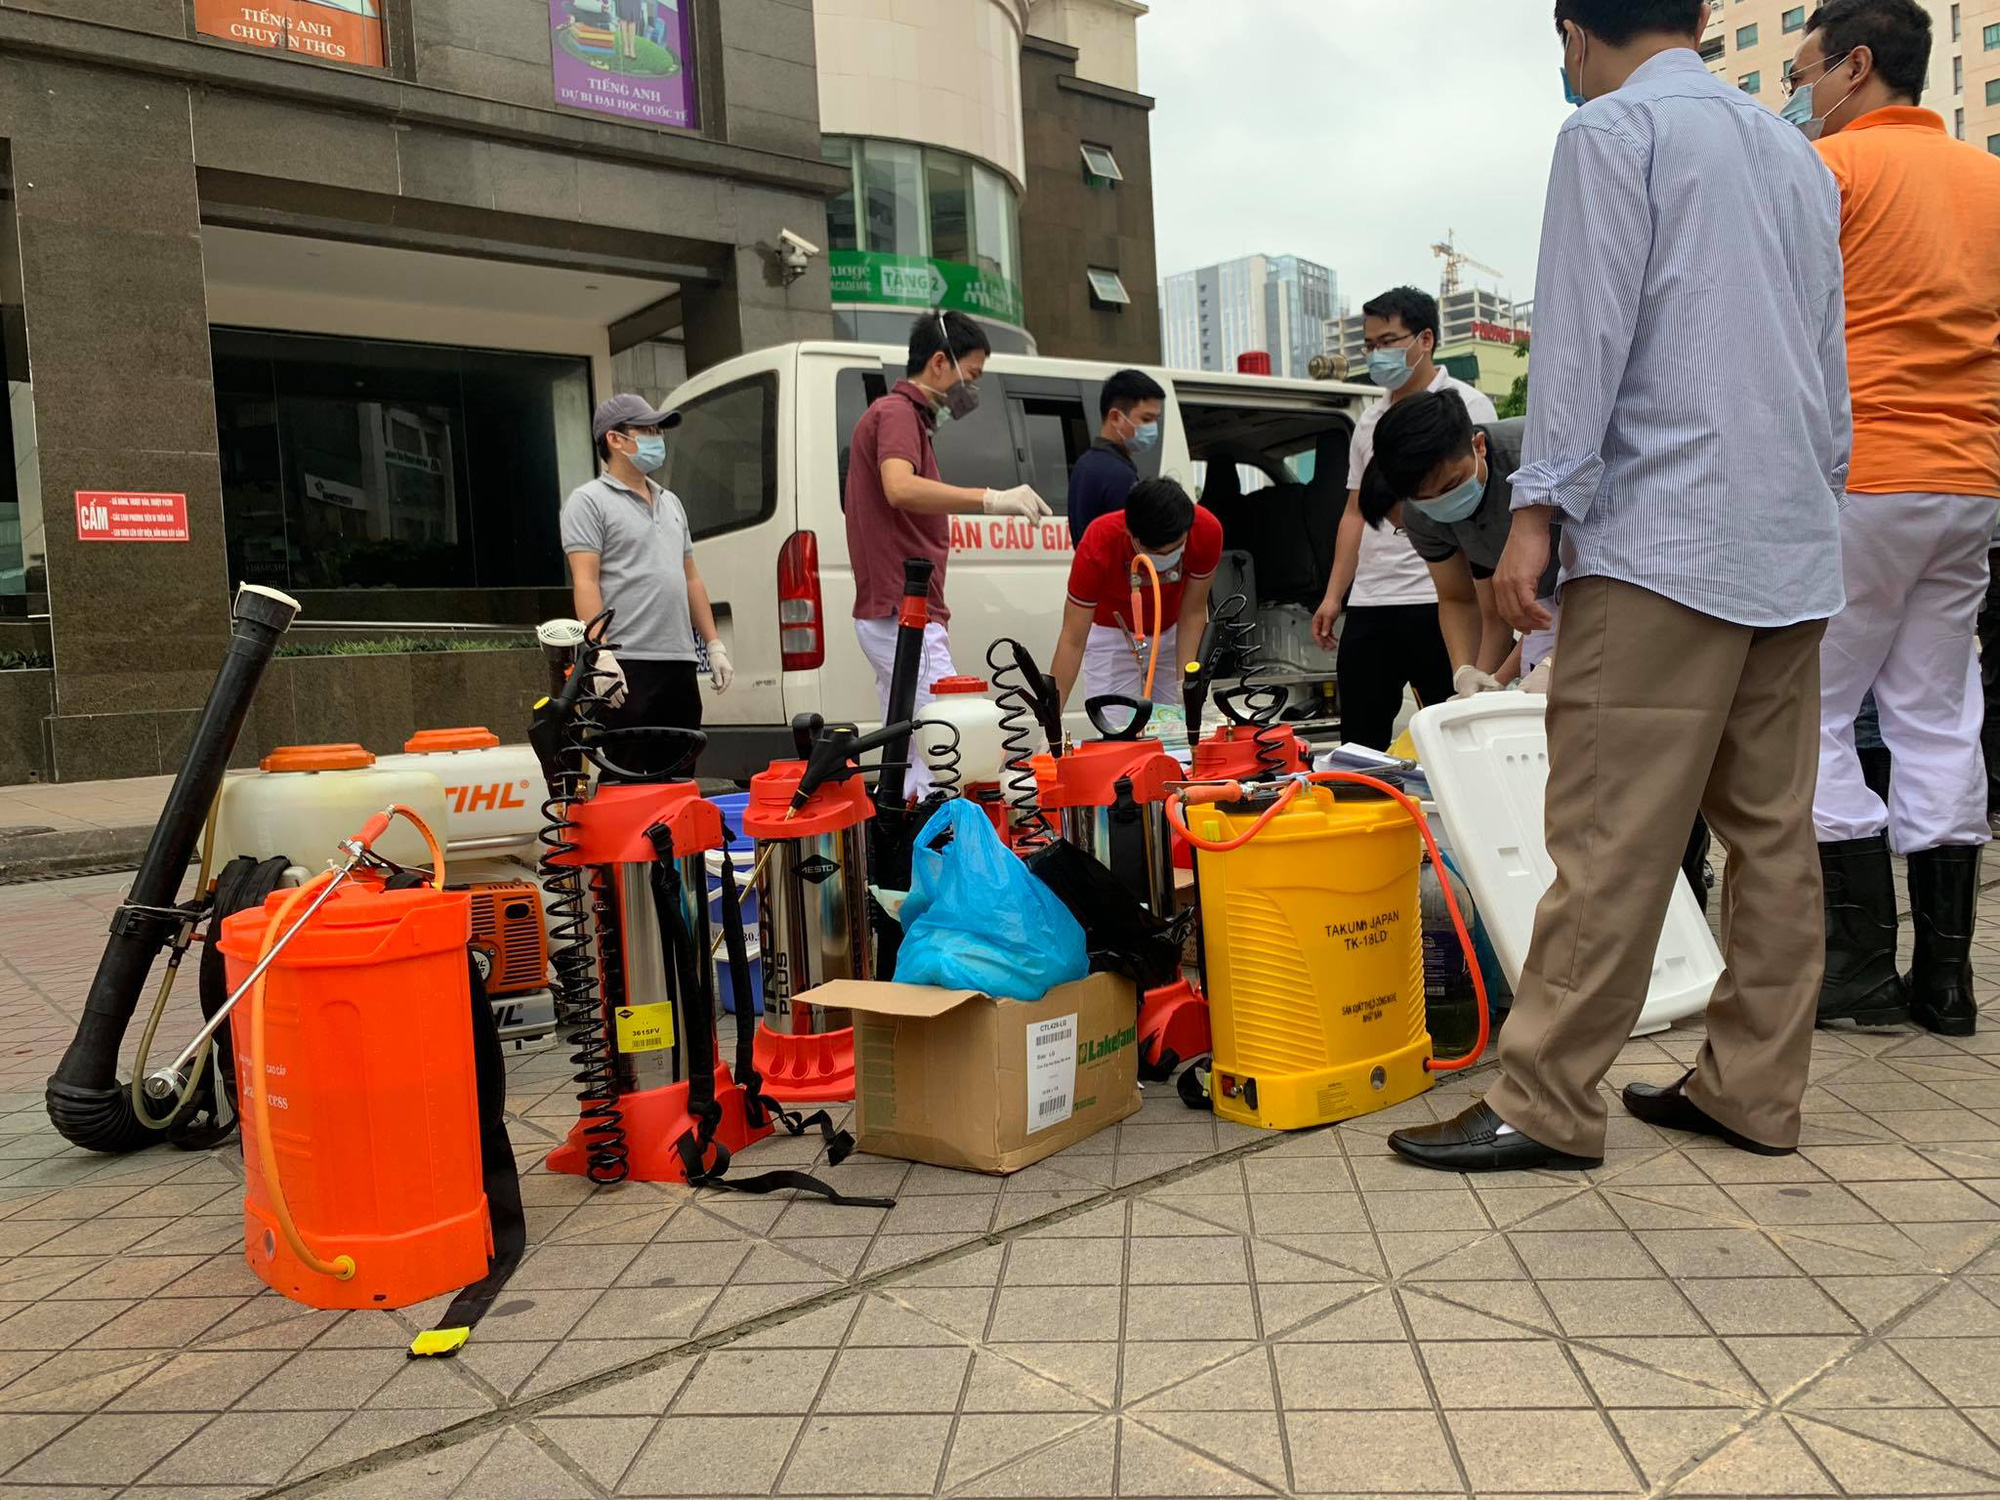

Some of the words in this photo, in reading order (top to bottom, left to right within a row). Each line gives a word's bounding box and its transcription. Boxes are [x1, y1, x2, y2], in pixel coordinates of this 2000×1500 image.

[241, 7, 293, 30] TIẾNG
[297, 20, 332, 37] ANH
[303, 38, 346, 57] THCS
[587, 77, 629, 96] TIẾNG
[632, 87, 661, 102] ANH
[931, 277, 939, 291] 2
[80, 498, 109, 531] CẤM
[1370, 910, 1399, 929] JAPAN
[777, 952, 790, 1015] PLUS
[632, 1027, 660, 1036] 3615FV
